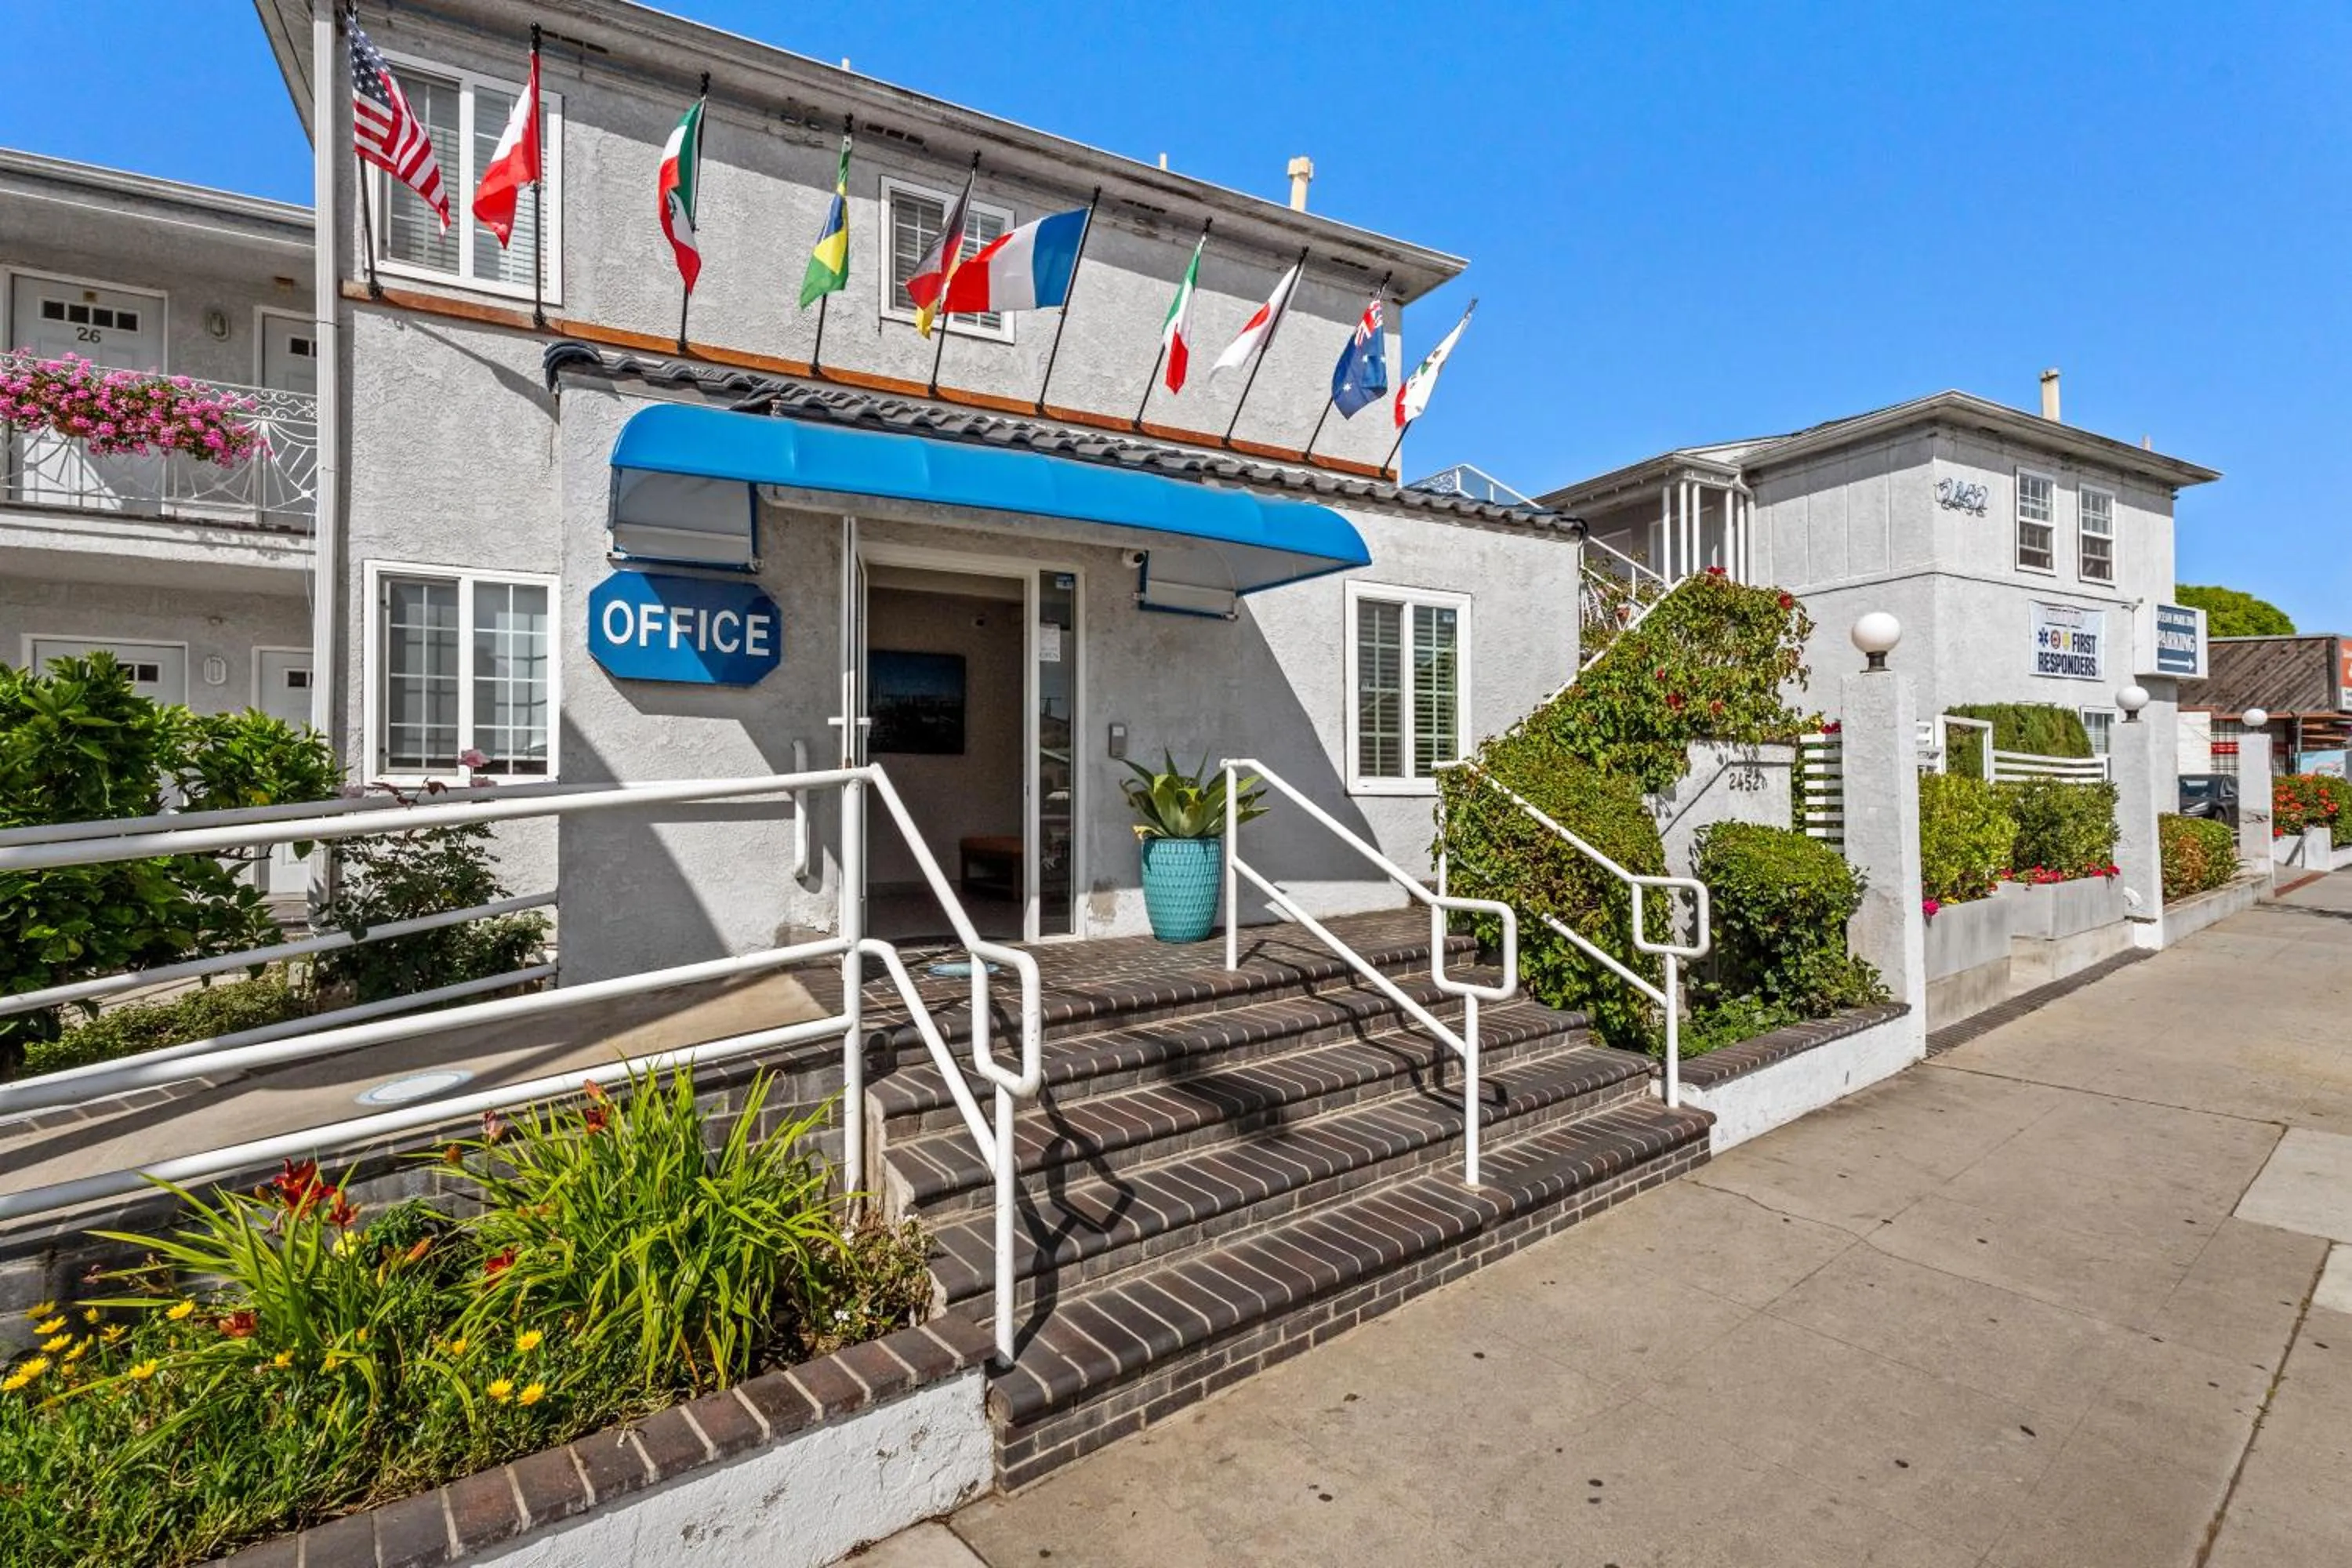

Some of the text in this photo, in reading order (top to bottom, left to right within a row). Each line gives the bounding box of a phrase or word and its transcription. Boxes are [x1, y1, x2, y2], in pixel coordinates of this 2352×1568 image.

[76, 326, 102, 344] 26
[602, 600, 771, 656] OFFICE
[2071, 632, 2097, 655] FIRST
[2157, 630, 2195, 653] PARKING
[2038, 652, 2096, 677] RESPONDERS
[1729, 772, 1760, 792] 2452
